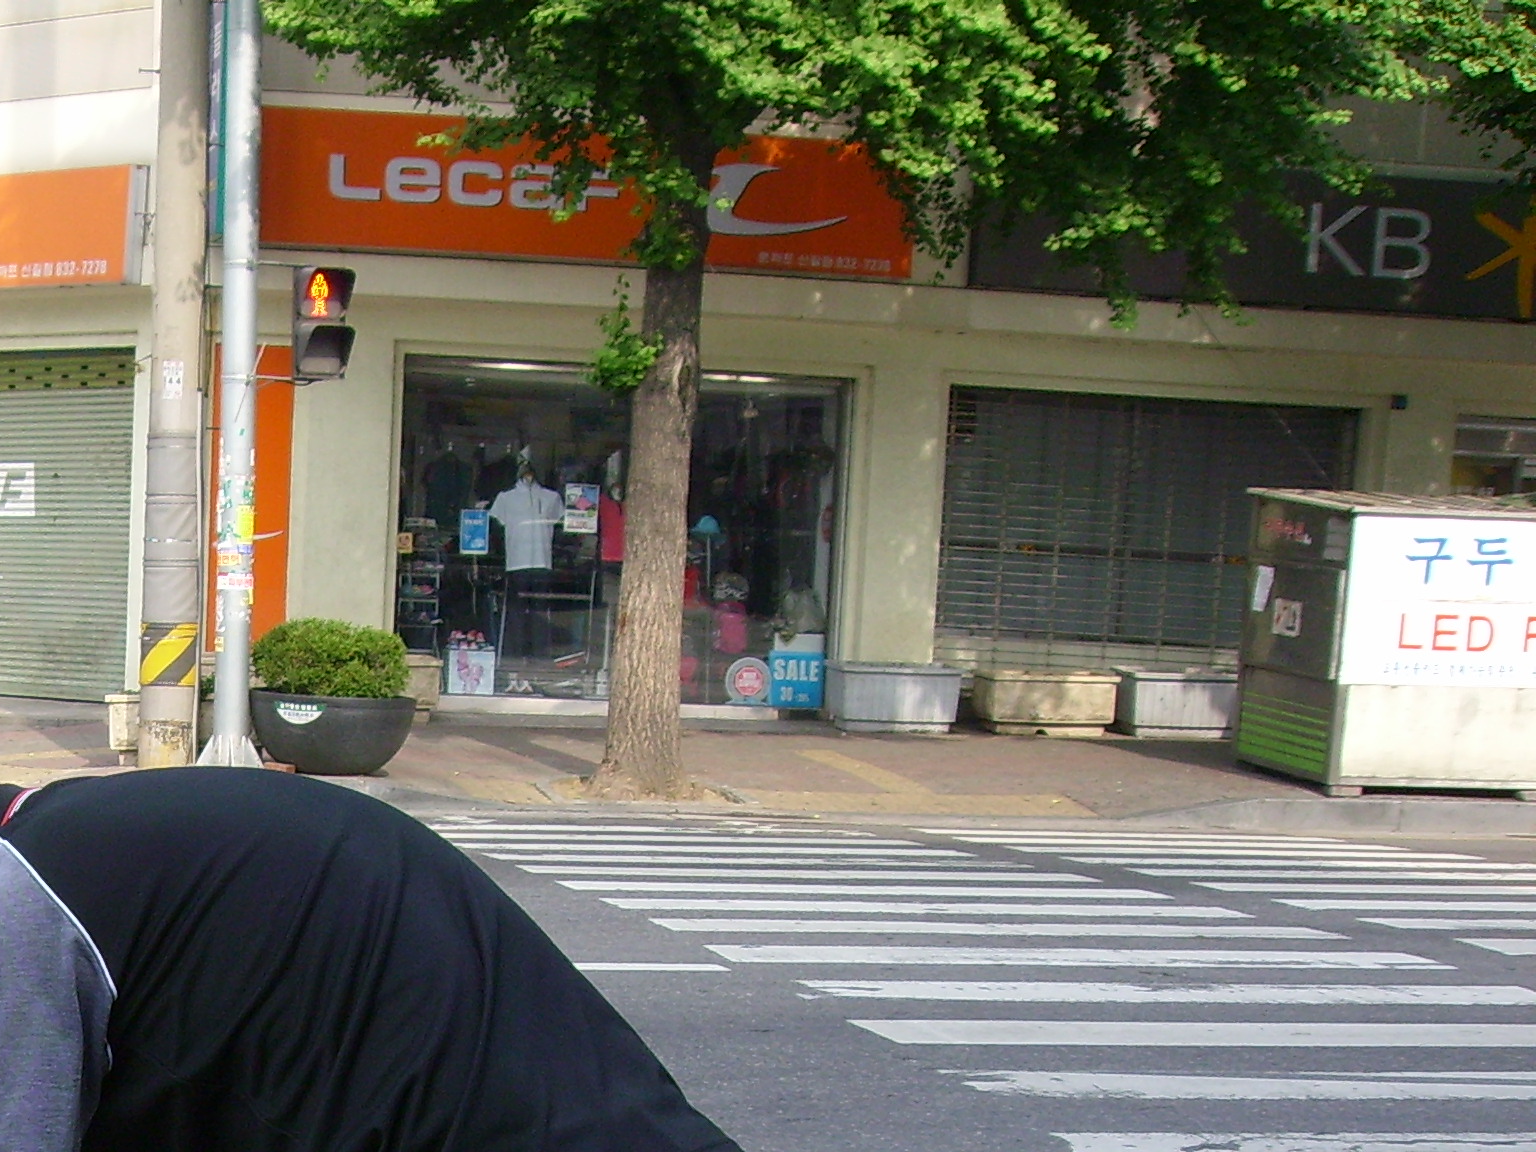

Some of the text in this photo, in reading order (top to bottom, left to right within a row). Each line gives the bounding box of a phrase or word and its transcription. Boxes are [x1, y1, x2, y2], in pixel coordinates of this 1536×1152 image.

[1306, 203, 1432, 279] KB
[1397, 613, 1495, 652] LED
[773, 658, 820, 682] SALE
